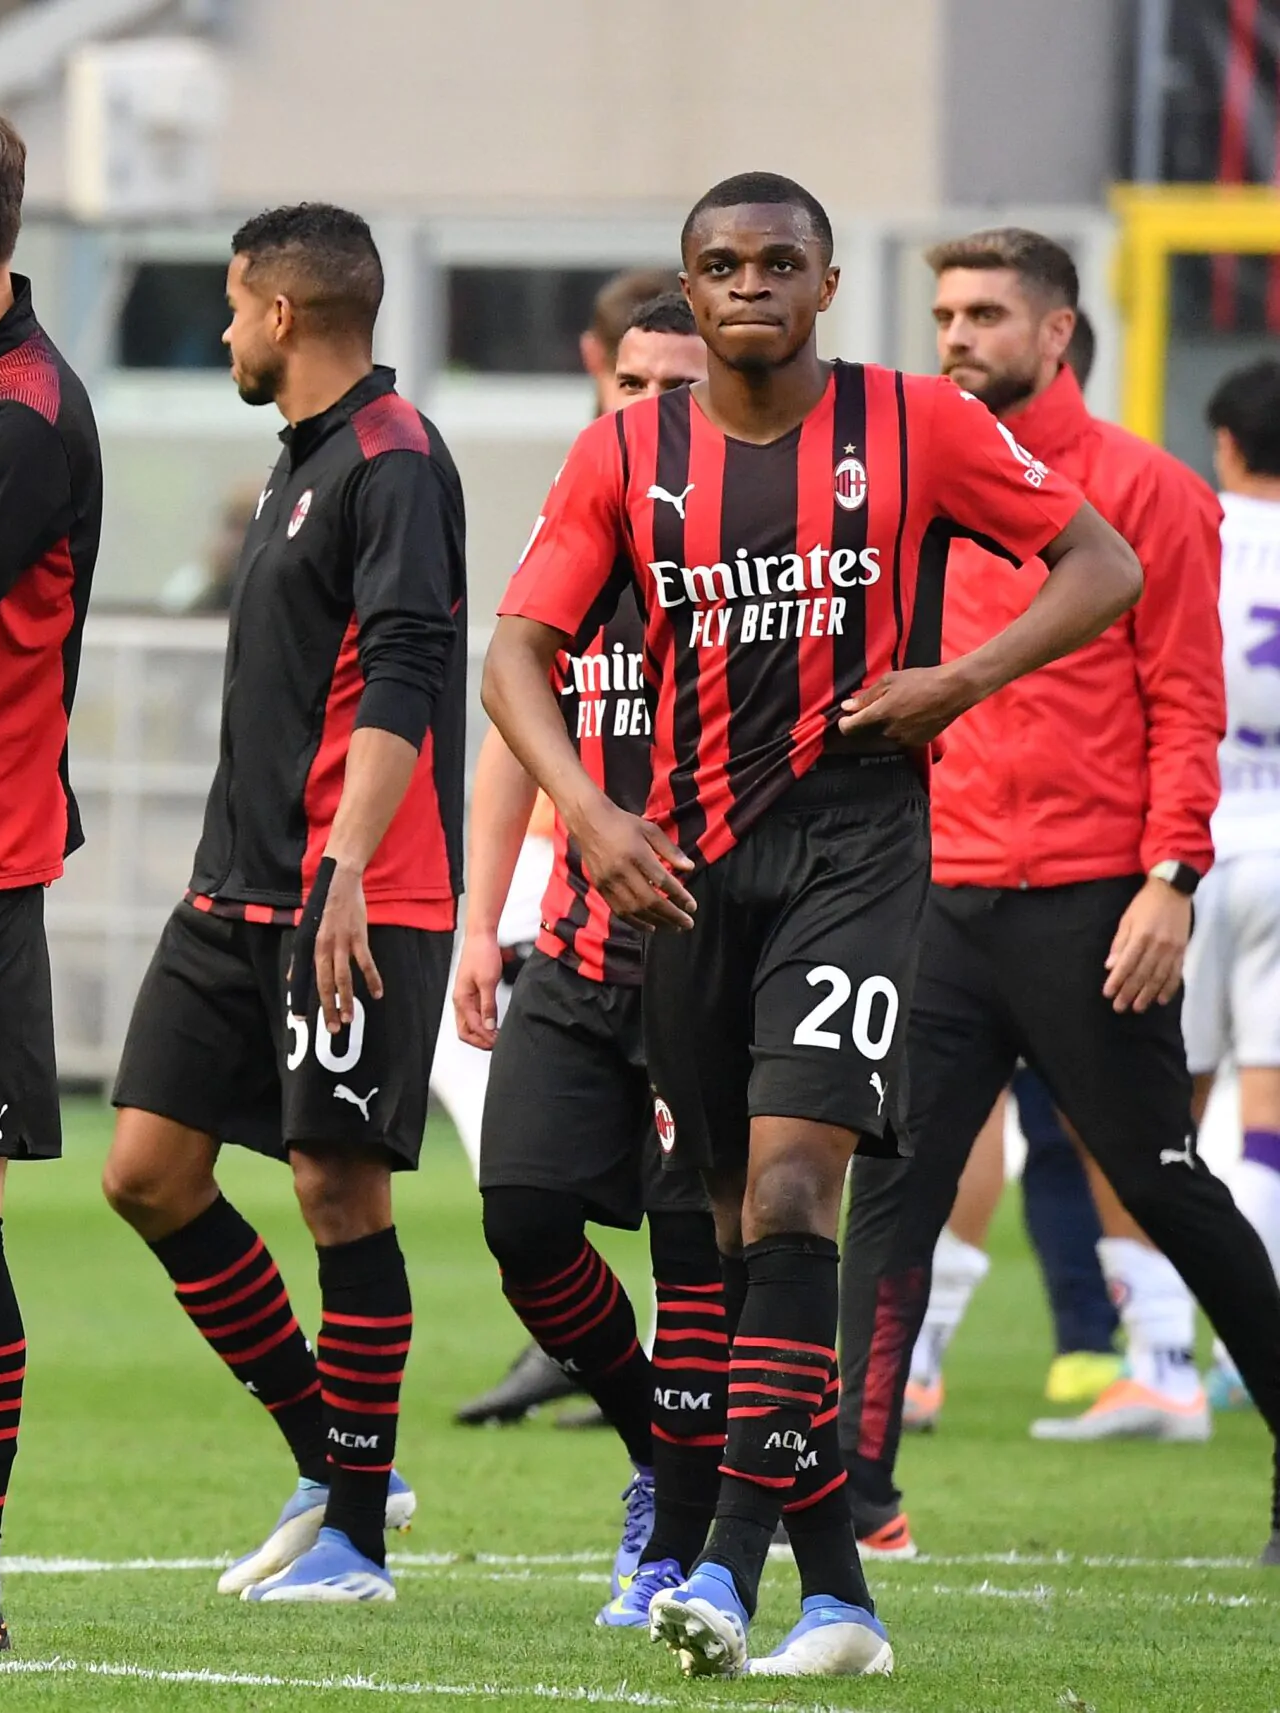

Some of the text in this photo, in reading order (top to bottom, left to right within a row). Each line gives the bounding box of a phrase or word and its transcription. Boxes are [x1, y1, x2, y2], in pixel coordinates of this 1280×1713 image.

[647, 543, 881, 608] Emirates
[689, 597, 847, 648] FLY BETTER
[576, 699, 607, 738] FLY
[793, 965, 899, 1060] 20
[654, 1387, 712, 1410] ACM
[328, 1427, 380, 1449] ACM
